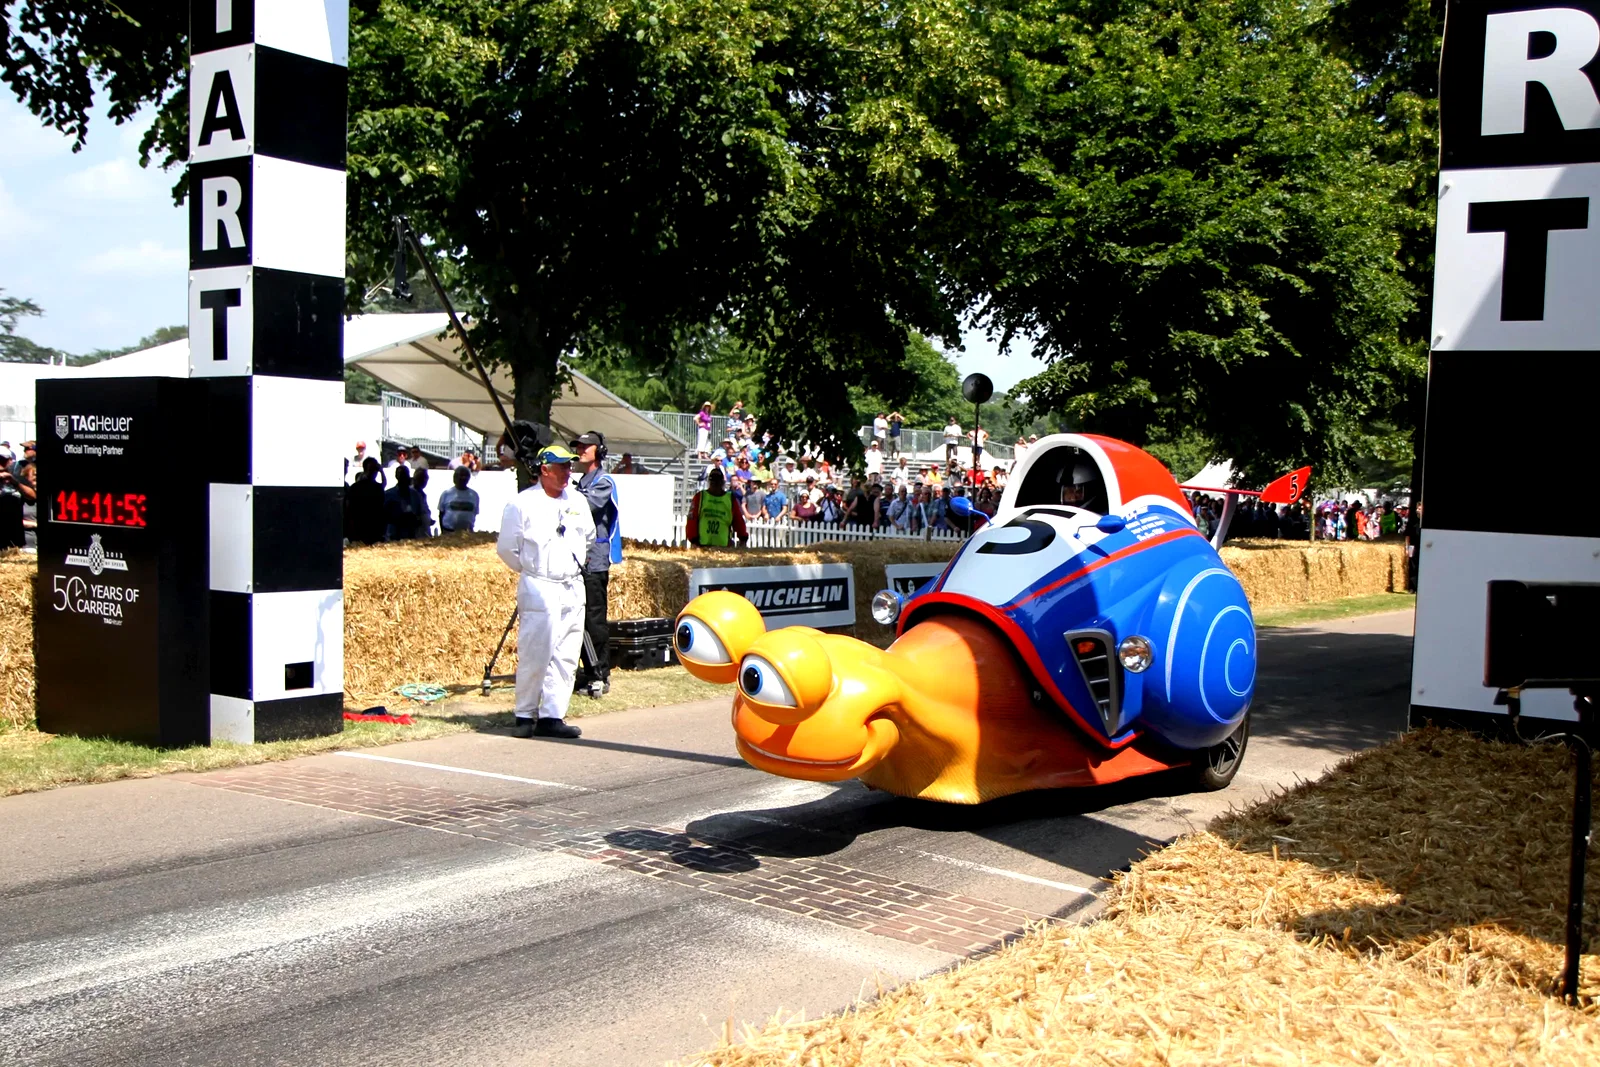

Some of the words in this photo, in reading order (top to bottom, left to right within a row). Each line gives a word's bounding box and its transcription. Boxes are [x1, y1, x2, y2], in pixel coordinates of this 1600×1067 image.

[64, 444, 82, 454] Official
[83, 444, 102, 457] Timing
[102, 445, 124, 455] Partner
[1290, 474, 1299, 501] 5
[706, 520, 720, 535] 302
[975, 508, 1077, 555] 5
[91, 584, 123, 601] YEARS
[125, 588, 140, 603] OF
[744, 584, 843, 607] MICHELIN
[76, 598, 123, 618] CARRERA
